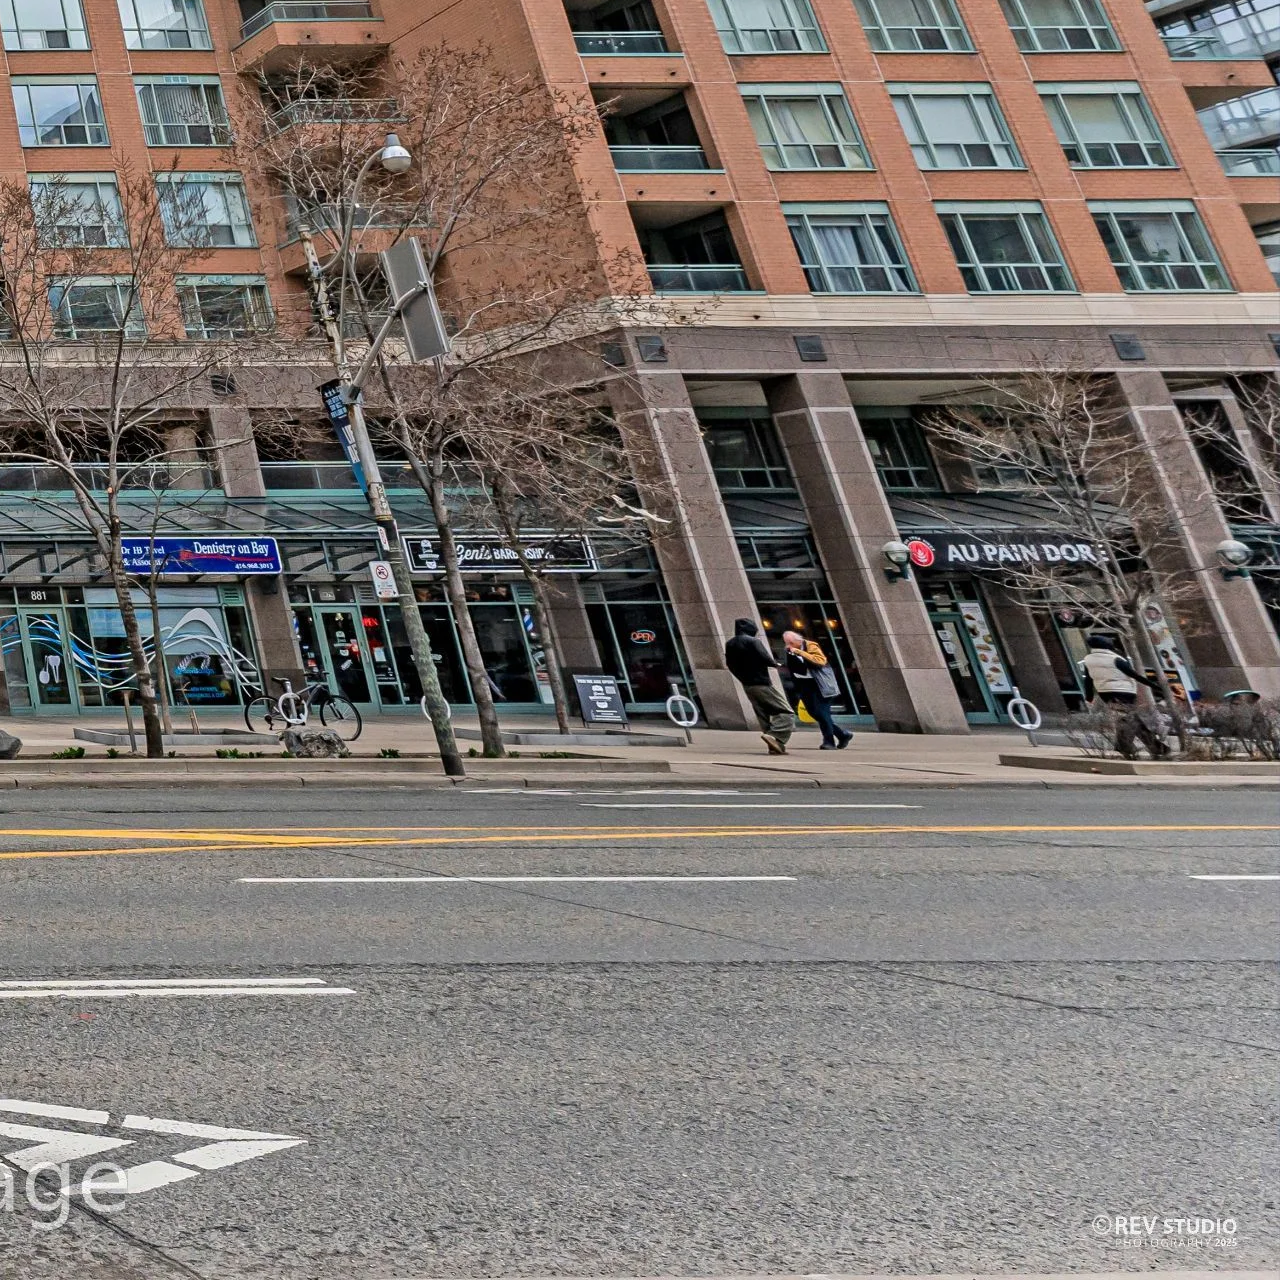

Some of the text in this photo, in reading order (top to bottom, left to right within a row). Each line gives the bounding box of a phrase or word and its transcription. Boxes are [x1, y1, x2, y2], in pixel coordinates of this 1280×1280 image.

[121, 546, 130, 554] Dr
[144, 545, 165, 555] Tvel
[193, 541, 269, 557] Dentistry on Bay
[948, 544, 981, 562] AU
[981, 544, 1041, 562] PAIN
[30, 590, 48, 601] 881
[631, 632, 655, 641] OPEN
